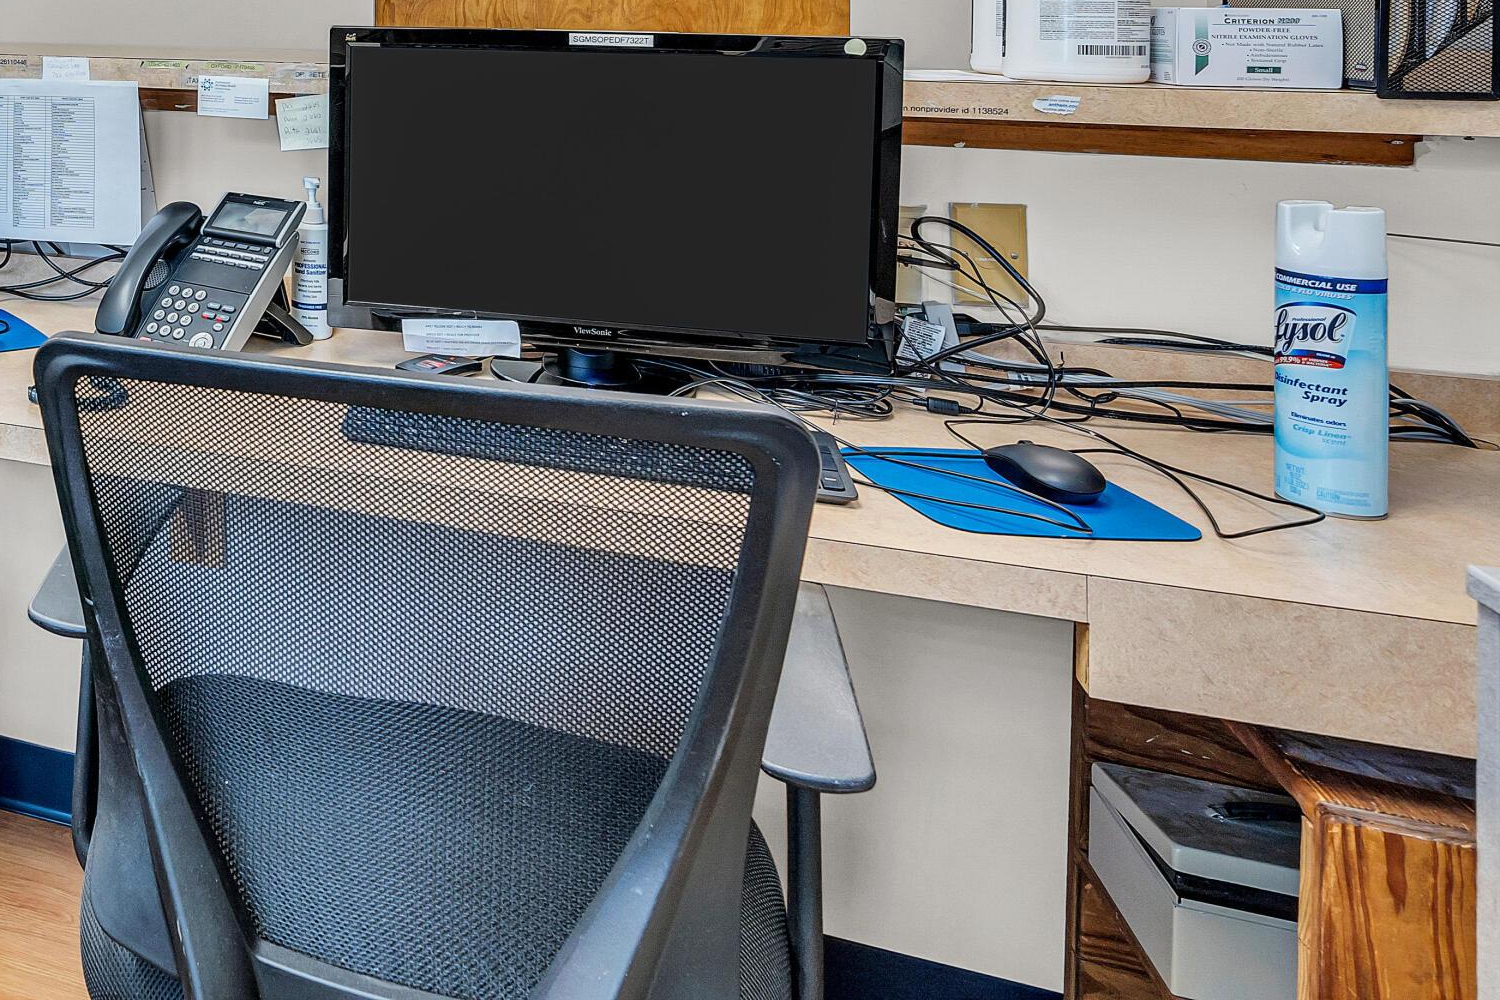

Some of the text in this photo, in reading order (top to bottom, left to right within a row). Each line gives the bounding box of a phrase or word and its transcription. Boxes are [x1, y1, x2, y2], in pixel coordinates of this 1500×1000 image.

[1224, 17, 1275, 25] CRITERION
[910, 106, 959, 114] nonprovider
[961, 106, 969, 114] id
[973, 107, 1009, 115] 1138524
[1336, 283, 1357, 291] USE
[574, 326, 612, 337] ViewSonic
[1275, 372, 1348, 396] Disinfectant
[1302, 391, 1348, 407] Spray
[1291, 411, 1347, 427] Eliminates odors
[1292, 424, 1347, 440] Crisp Linen
